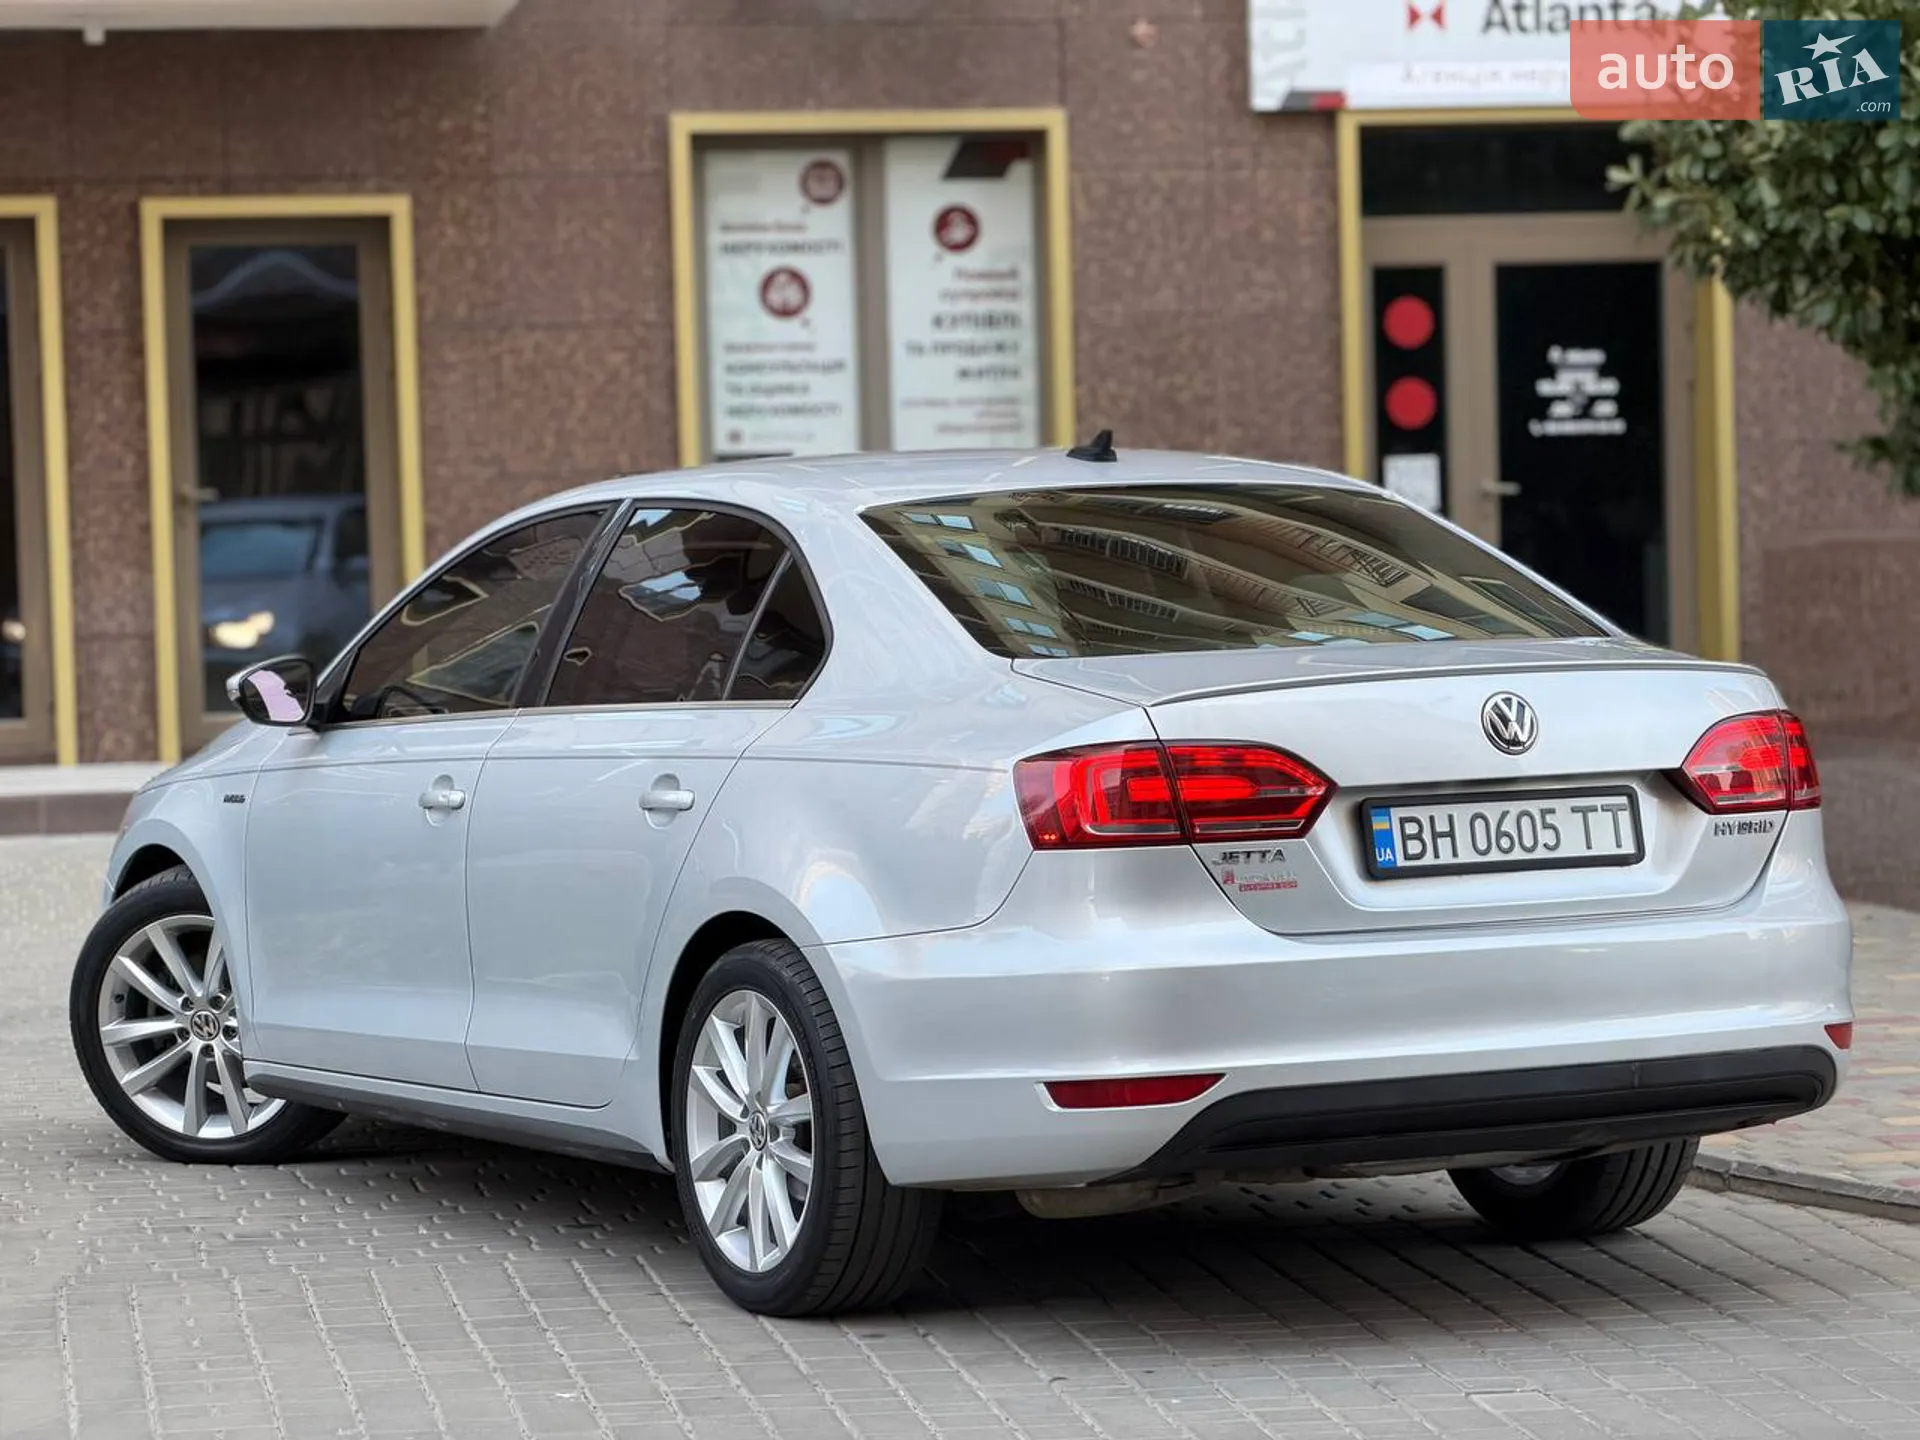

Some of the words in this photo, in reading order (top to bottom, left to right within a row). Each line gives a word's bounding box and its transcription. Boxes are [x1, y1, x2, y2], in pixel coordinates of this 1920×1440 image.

[1399, 813, 1459, 861] BH
[1469, 808, 1562, 857] 0605
[1571, 802, 1629, 851] TT
[1714, 819, 1774, 837] HYBRID
[1211, 848, 1287, 866] JETTA
[1376, 847, 1395, 863] UA
